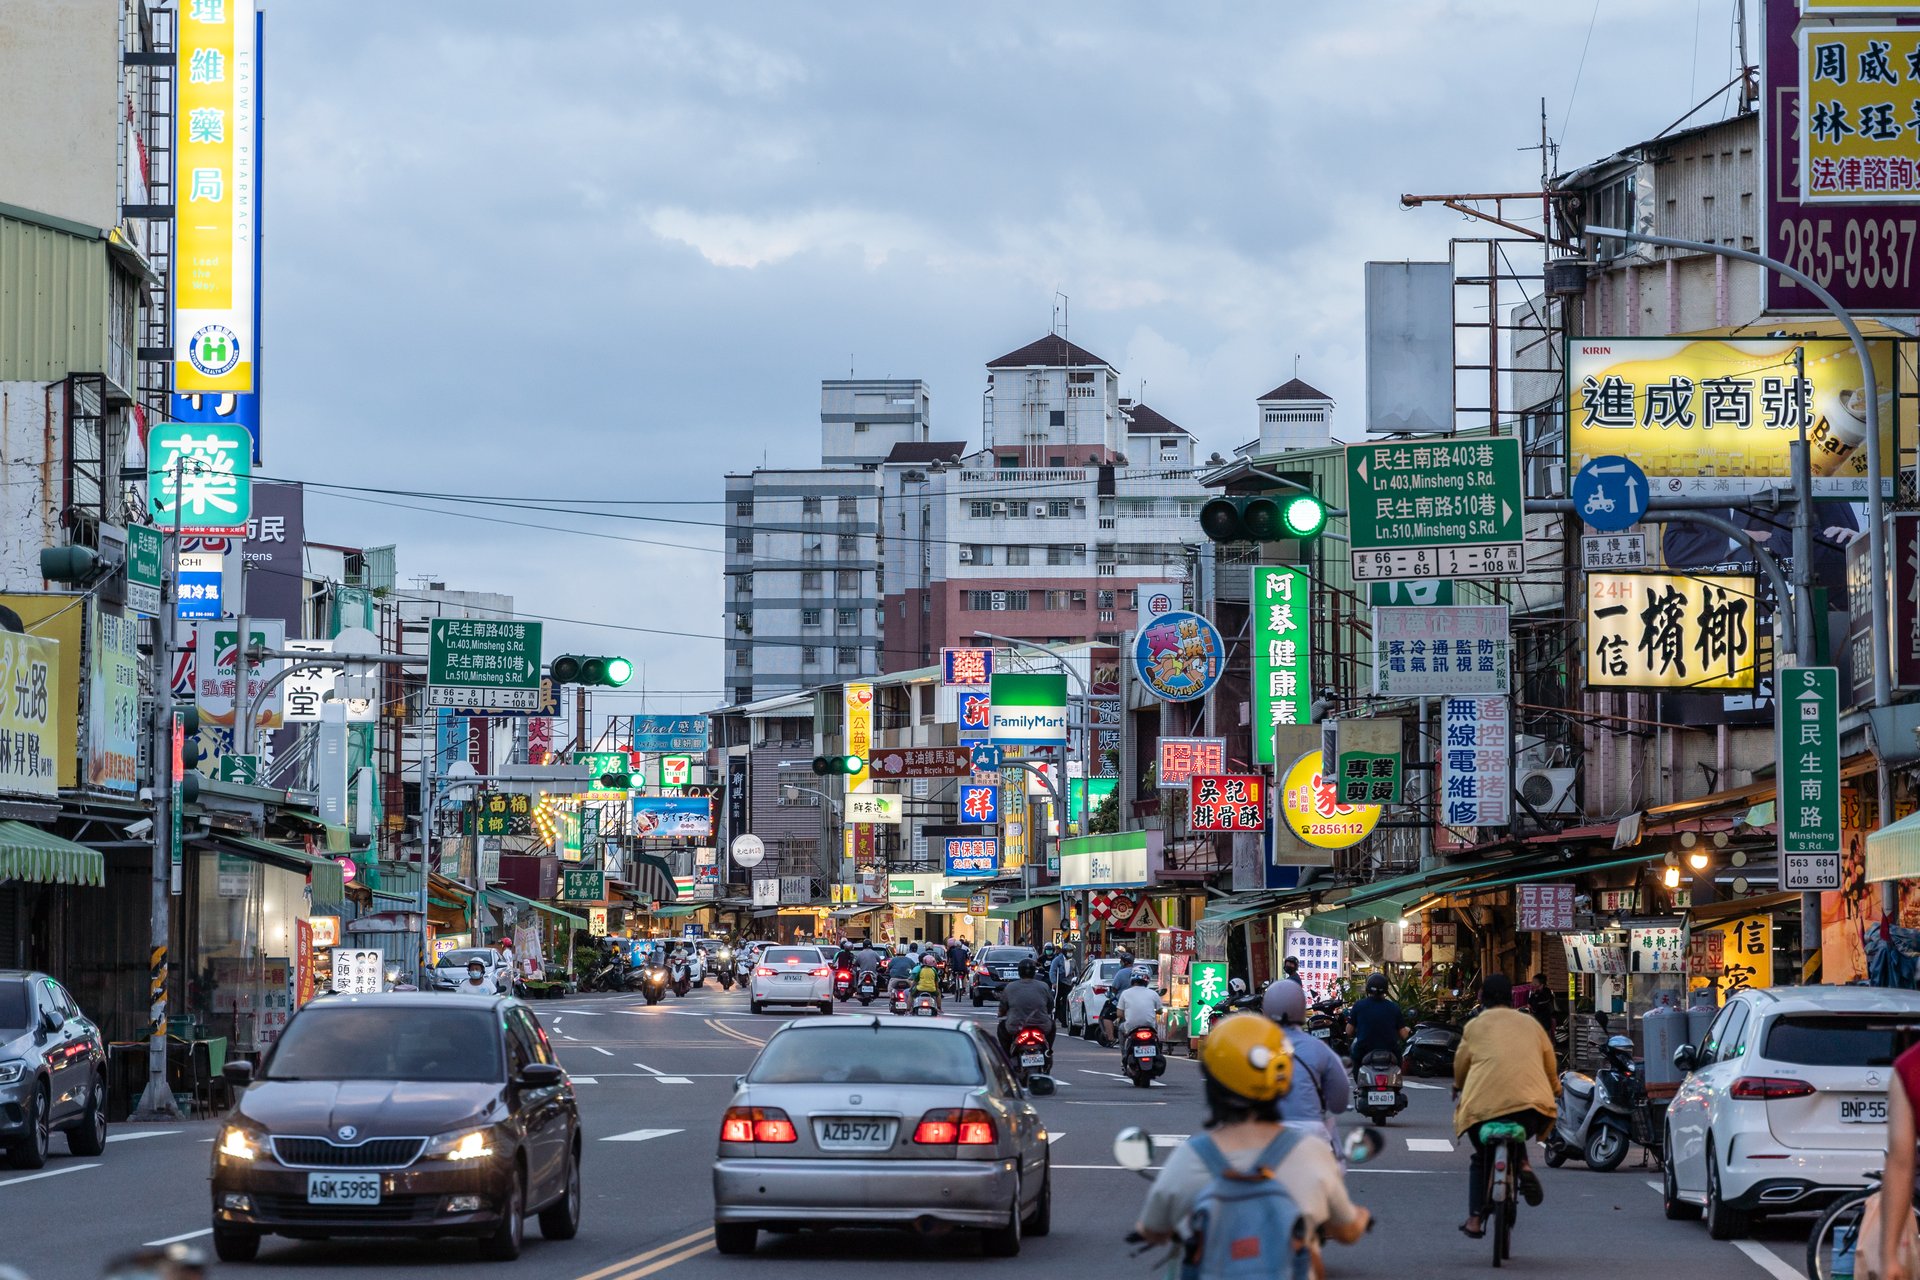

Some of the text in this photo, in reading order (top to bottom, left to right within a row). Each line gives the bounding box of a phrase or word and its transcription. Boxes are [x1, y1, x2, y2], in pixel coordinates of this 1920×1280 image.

[239, 51, 249, 242] LEADWAY PHARMACY
[1779, 218, 1917, 289] 285-9337
[1582, 347, 1611, 355] KIRIN
[1582, 375, 1814, 430] 進成商號
[1374, 444, 1494, 471] 民生南路403巷
[161, 434, 239, 515] 藥
[1376, 493, 1496, 520] 民生南路510巷
[1586, 537, 1641, 552] 機慢車
[1375, 553, 1391, 563] 66
[1418, 551, 1425, 561] 8
[1450, 550, 1456, 560] 1
[1484, 548, 1500, 558] 67
[1508, 548, 1517, 558] 西
[1587, 552, 1641, 566] 兩段左轉
[1376, 565, 1392, 576] 79
[1414, 564, 1430, 574] 65
[1451, 562, 1457, 573] 2
[1482, 561, 1504, 572] 108
[1594, 582, 1633, 599] 24H
[1152, 597, 1168, 613] 郵
[447, 621, 526, 639] 民生南路403巷
[1638, 584, 1748, 679] 檳榔
[446, 639, 525, 653] Ln.403,Minsheng S.Rd.
[446, 653, 524, 671] 民生南路510巷
[953, 651, 987, 685] 藥
[1266, 573, 1298, 755] 阿琴健康素
[445, 671, 524, 684] Ln.510,Minsheng S.Rd.
[1803, 671, 1821, 687] S.
[1803, 707, 1817, 715] 163
[993, 715, 1064, 730] FamilyMart
[904, 750, 956, 765] 嘉油鐵馬道
[1448, 699, 1477, 824] 無線電維修
[1476, 699, 1505, 824] 遙控器拷貝
[924, 766, 942, 774] Bicycle
[1346, 758, 1395, 778] 專業
[1799, 723, 1823, 828] 民生南路
[1198, 779, 1247, 803] 吳記
[1346, 781, 1394, 801] 剪燙
[965, 788, 994, 820] 祥
[1193, 805, 1262, 828] 排骨酥
[1311, 823, 1363, 835] 2856112
[1789, 831, 1834, 842] Minsheng
[949, 841, 995, 857] 健保藥局
[1799, 842, 1824, 850] S.Rd.
[1790, 859, 1834, 867] 563 684
[1790, 875, 1835, 884] 409 510
[1841, 1101, 1888, 1118] BNP-55
[823, 1123, 887, 1141] AZB-5721
[310, 1181, 379, 1199] AQK-5985
